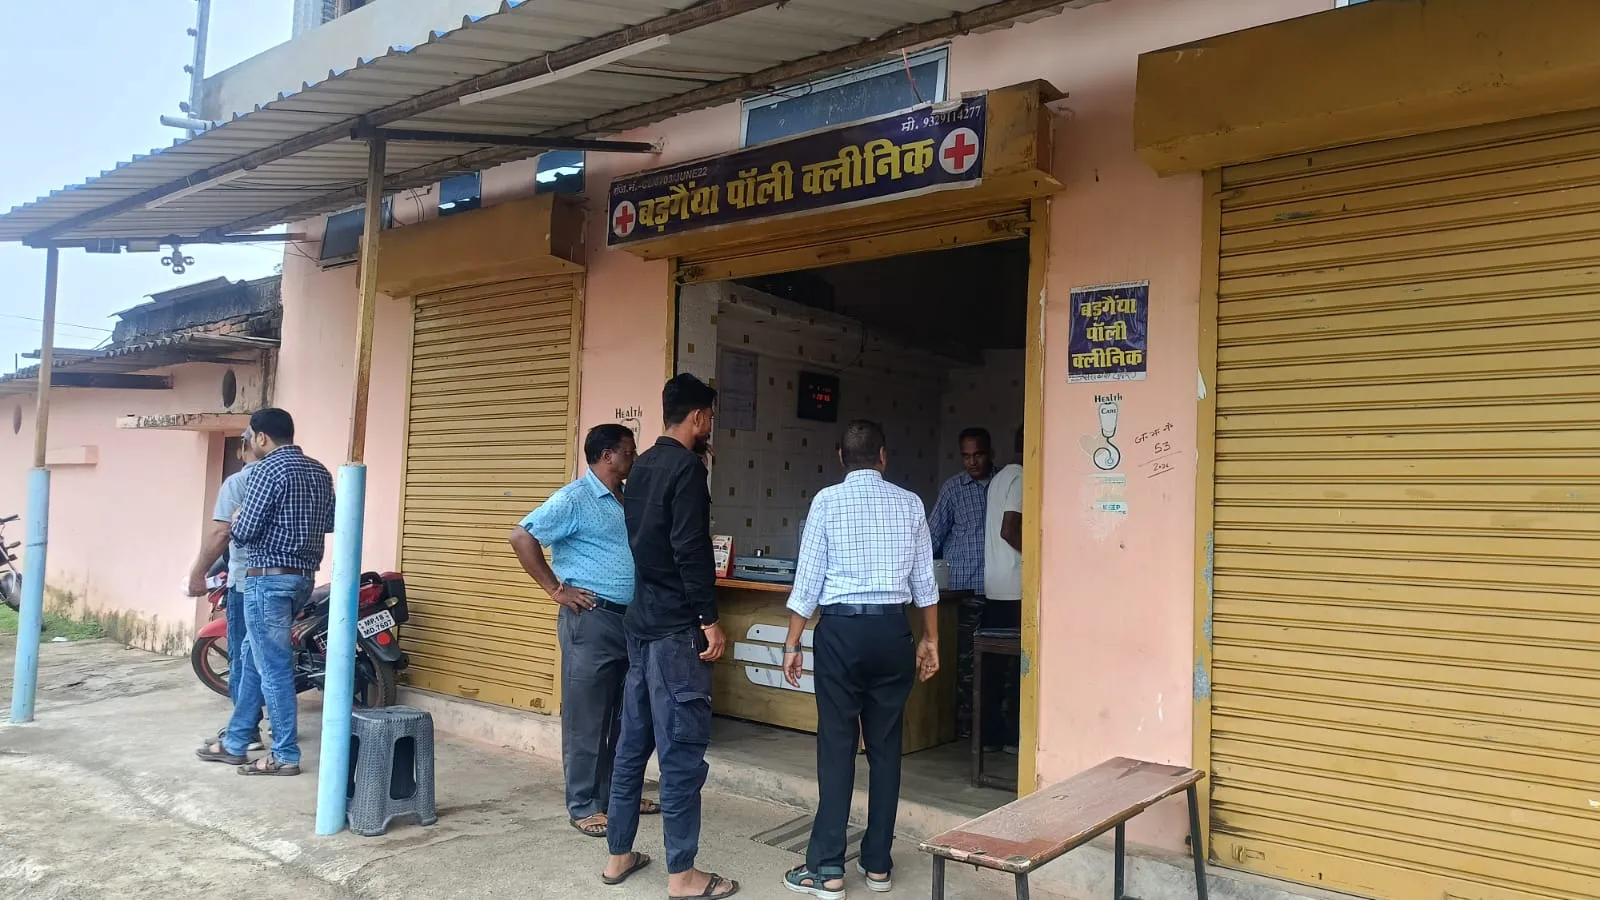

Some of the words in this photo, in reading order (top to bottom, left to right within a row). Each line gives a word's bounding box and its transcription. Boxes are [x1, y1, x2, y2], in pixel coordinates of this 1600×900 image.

[923, 105, 981, 128] 9329114277
[726, 160, 794, 209] पॉली
[801, 138, 936, 195] क्लीनिक
[1086, 320, 1127, 342] पॉली
[1072, 347, 1142, 368] क्लीनिक
[1154, 441, 1171, 454] 53
